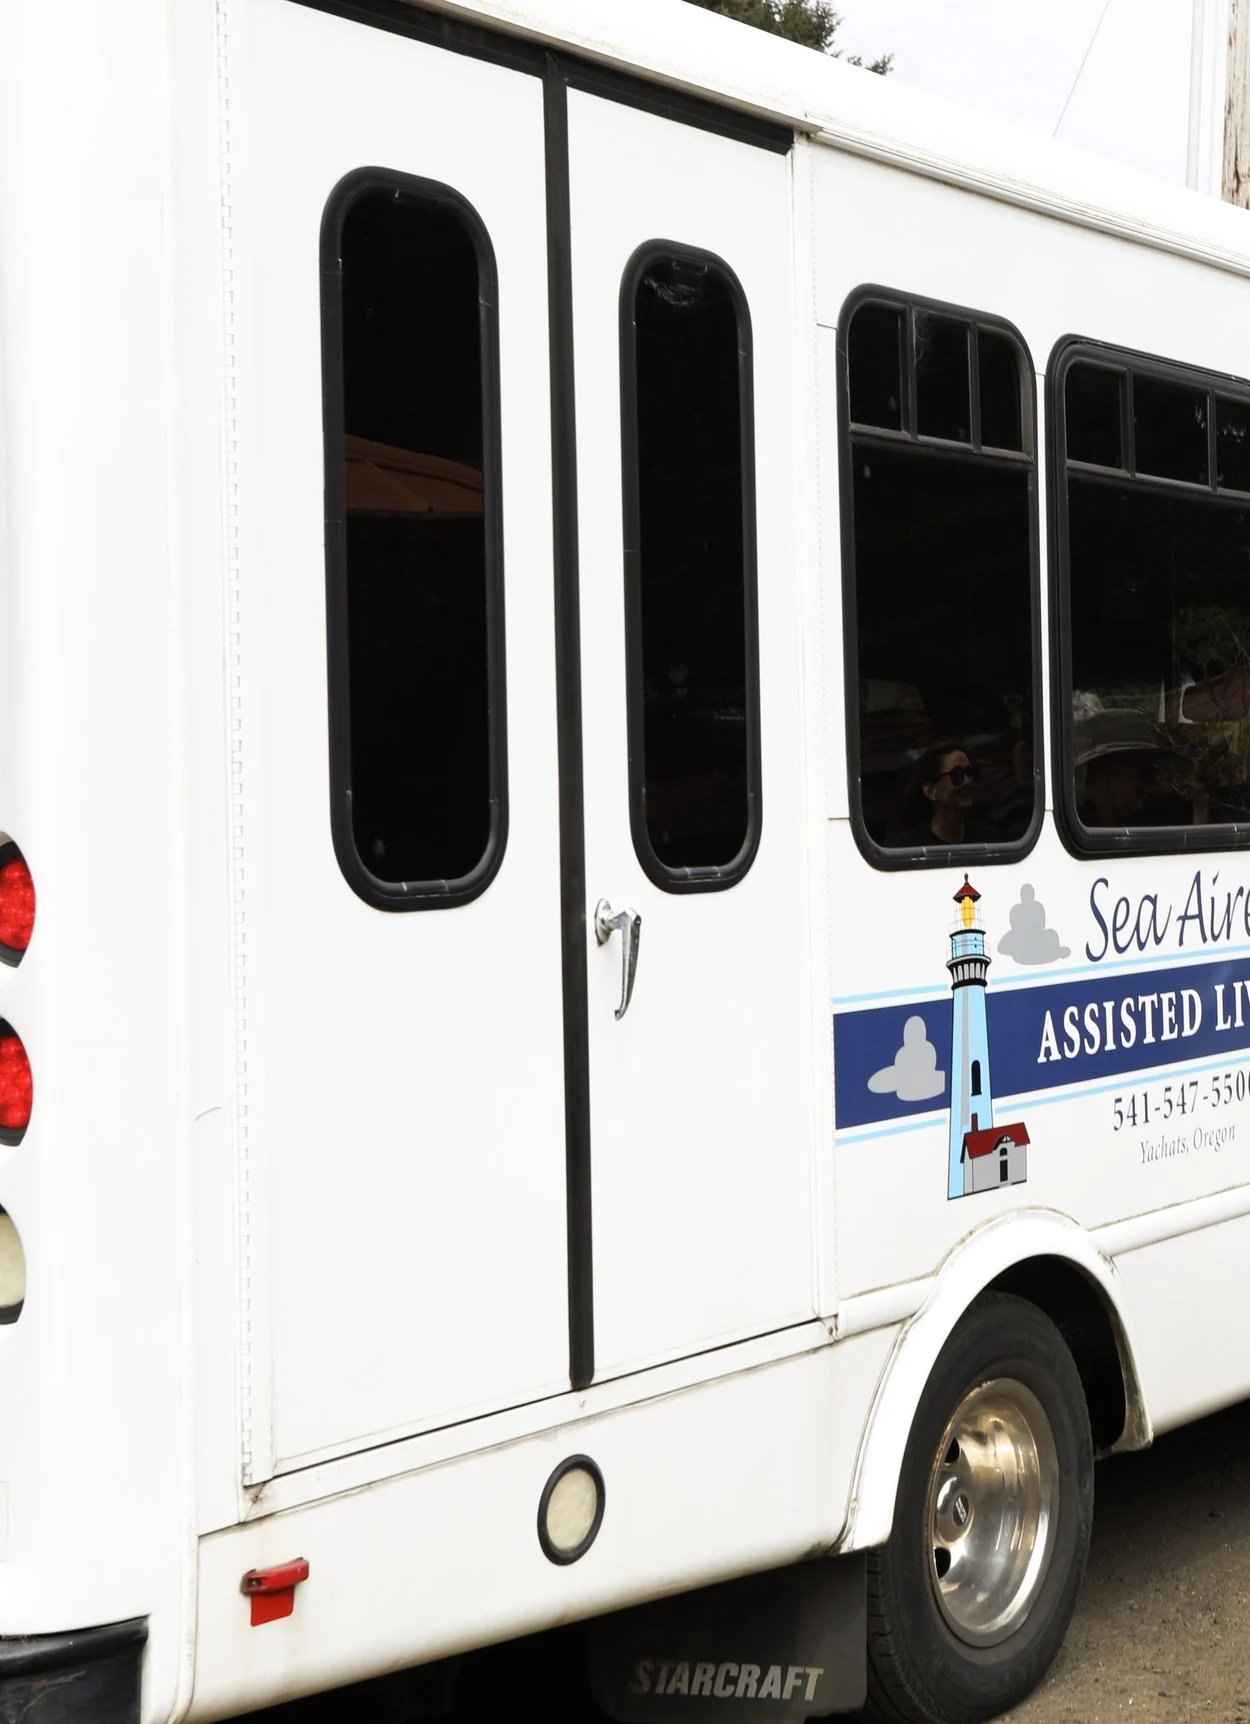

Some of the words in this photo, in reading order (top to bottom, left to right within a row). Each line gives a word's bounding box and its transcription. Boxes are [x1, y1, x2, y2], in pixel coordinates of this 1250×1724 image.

[1086, 877, 1172, 962] Sea
[1037, 988, 1202, 1063] ASSISTED
[1140, 1133, 1190, 1165] Yachats,
[1193, 1124, 1236, 1153] Oregon
[630, 1660, 824, 1701] STARCRAFT
